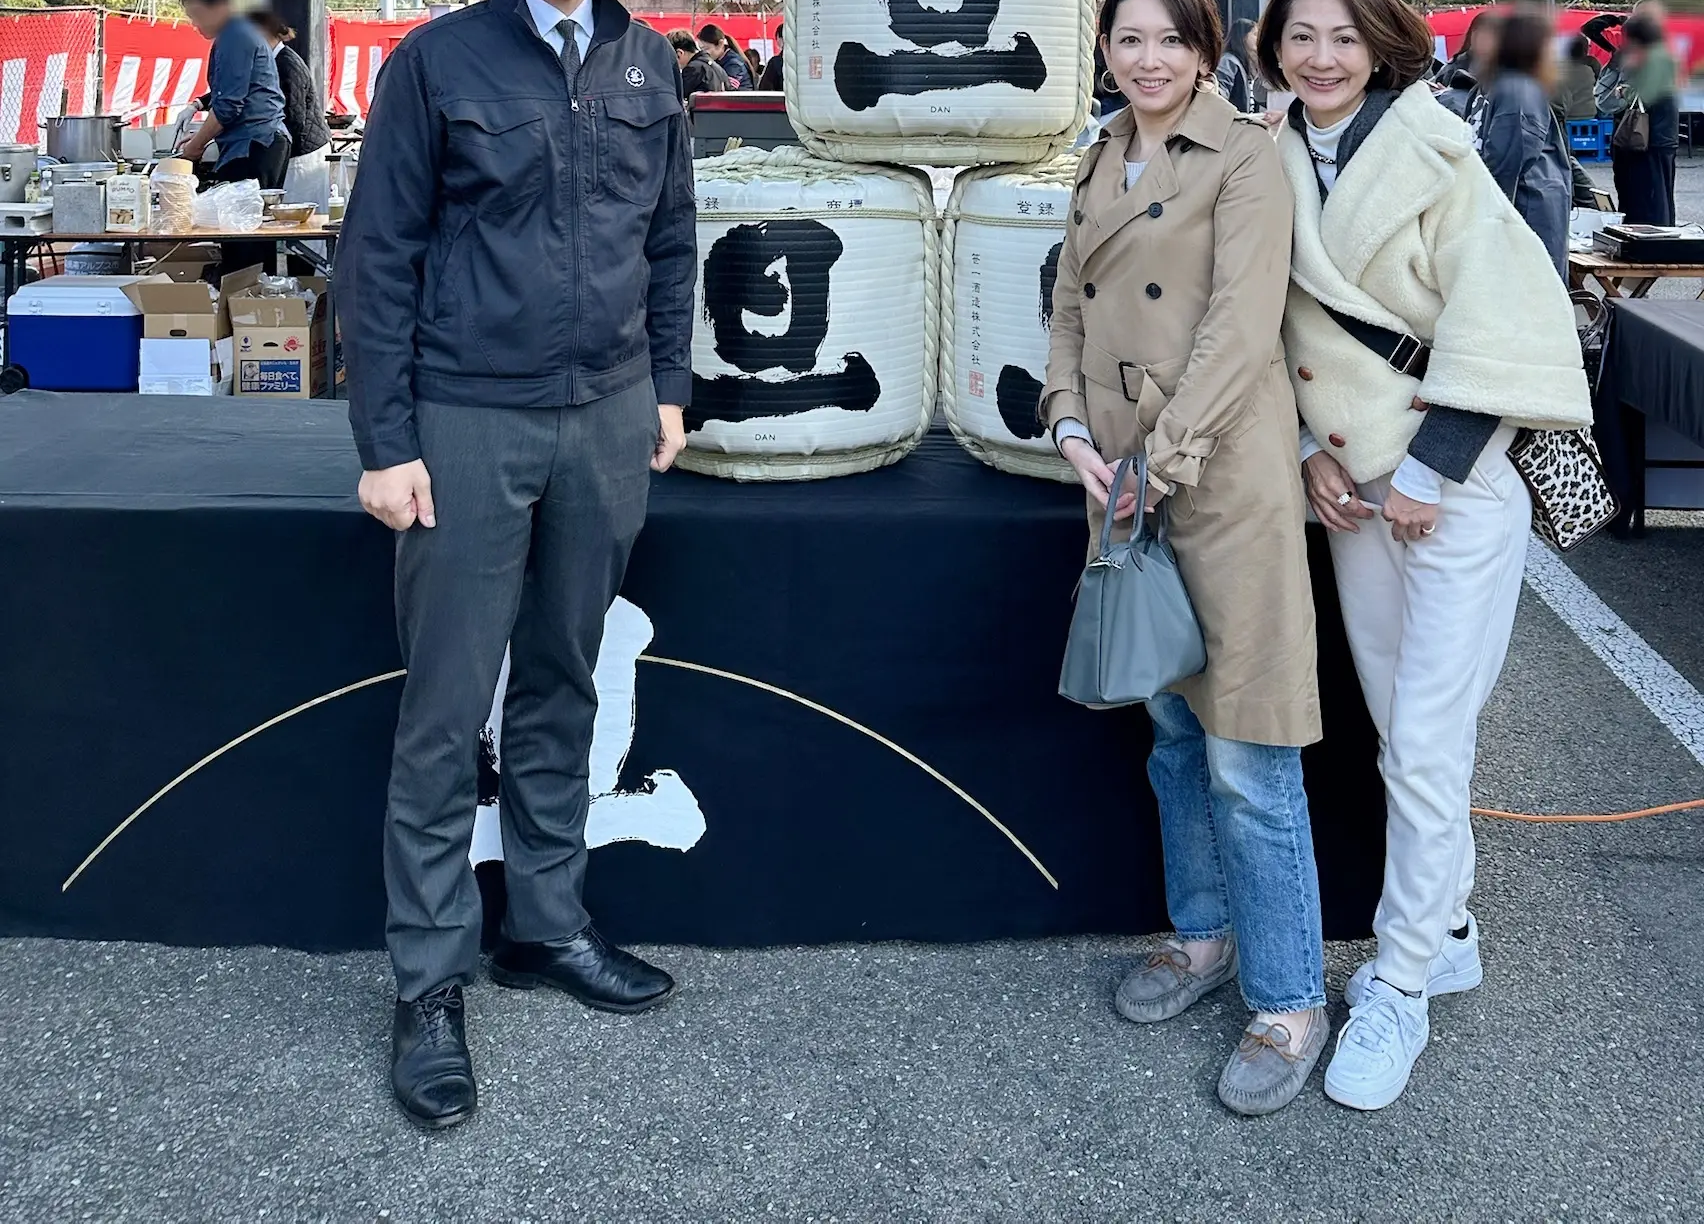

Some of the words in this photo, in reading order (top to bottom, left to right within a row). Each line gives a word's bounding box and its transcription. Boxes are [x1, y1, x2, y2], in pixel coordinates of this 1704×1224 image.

[693, 196, 720, 210] 録
[1016, 200, 1055, 216] 登録
[755, 433, 776, 441] DAN
